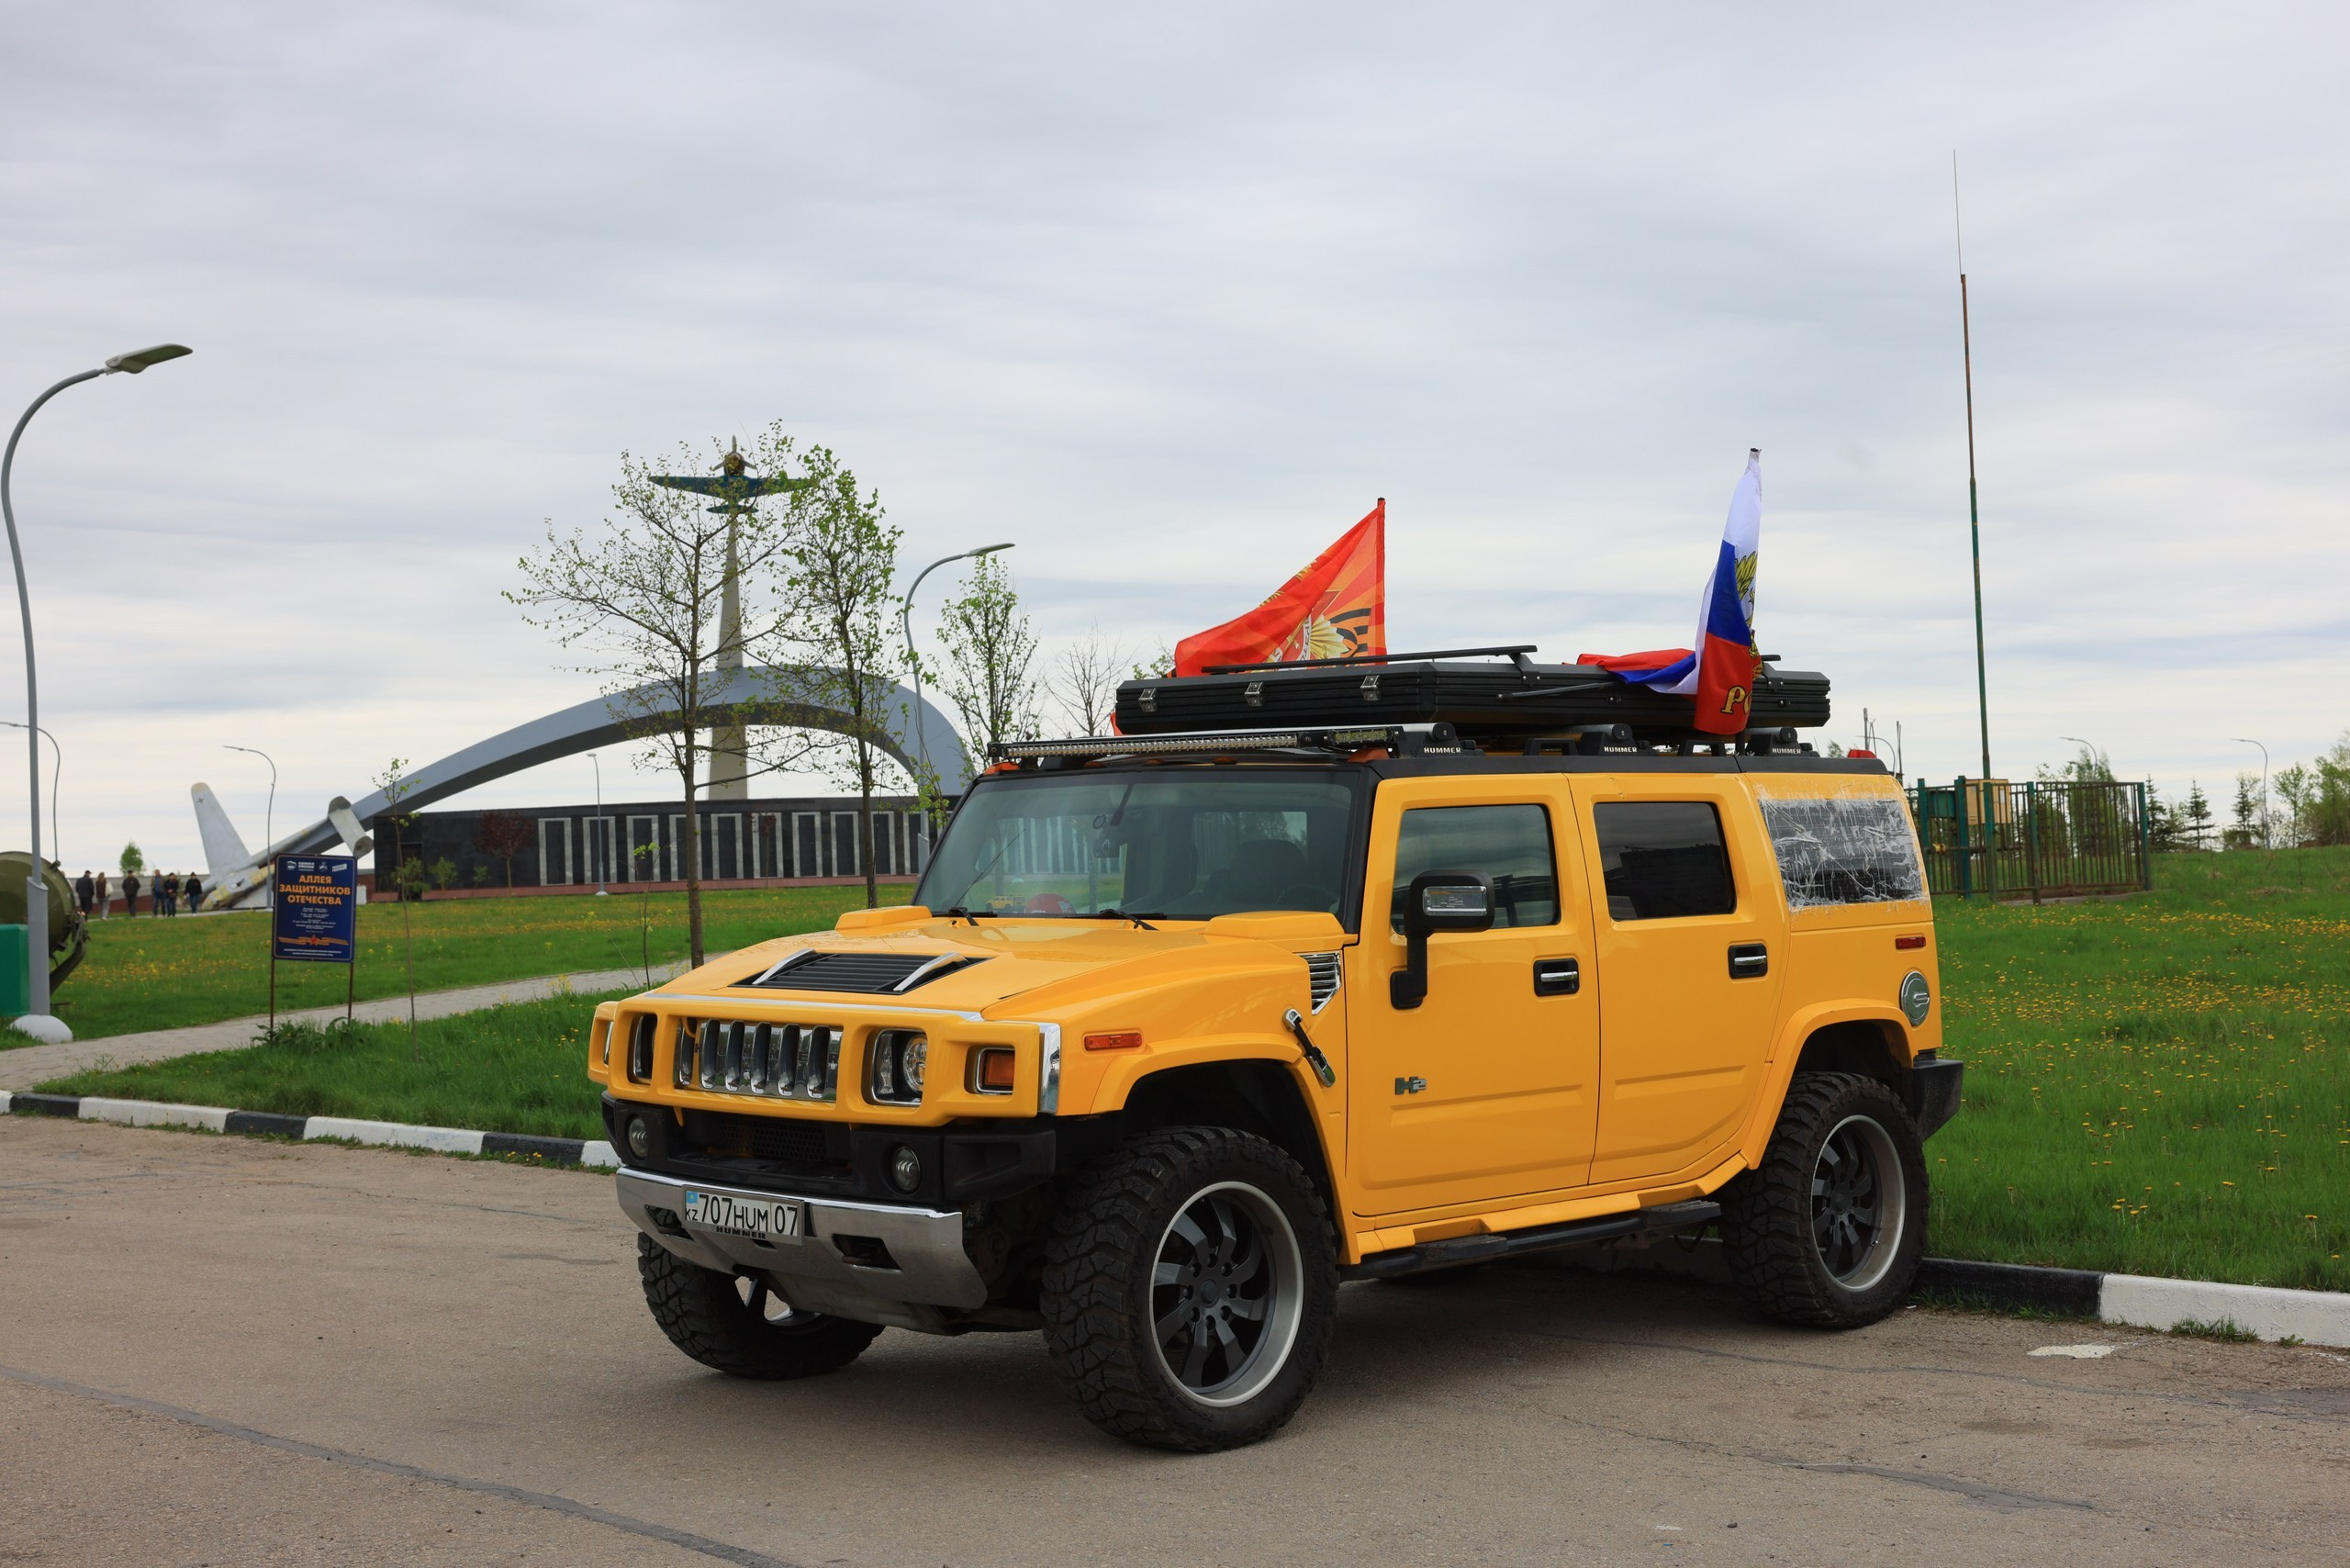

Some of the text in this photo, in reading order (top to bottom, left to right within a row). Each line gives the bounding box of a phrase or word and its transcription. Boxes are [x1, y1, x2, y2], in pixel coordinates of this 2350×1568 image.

[298, 875, 332, 884] АЛЛЕЯ
[279, 884, 352, 895] ЗАЩИТНИКОВ
[287, 894, 341, 905] ОТЕЧЕСТВА
[1394, 1076, 1427, 1095] H2
[685, 1208, 698, 1221] KZ
[774, 1204, 798, 1236] 07
[716, 1226, 766, 1239] HUMMER
